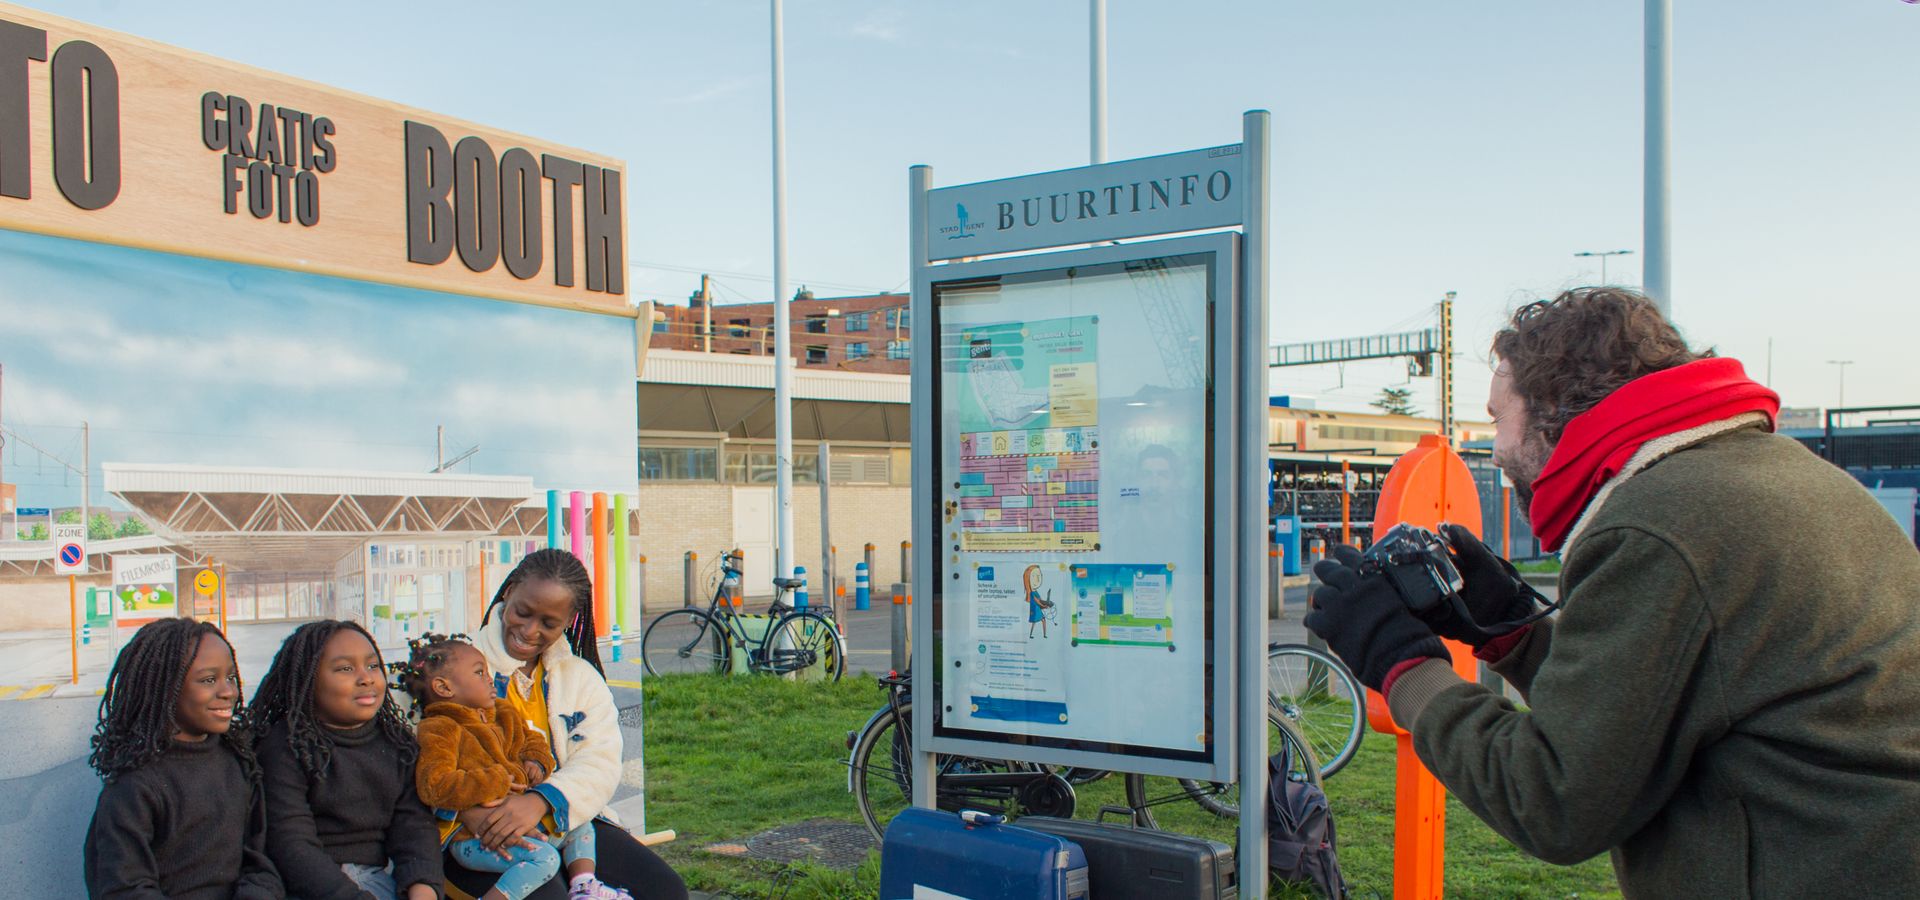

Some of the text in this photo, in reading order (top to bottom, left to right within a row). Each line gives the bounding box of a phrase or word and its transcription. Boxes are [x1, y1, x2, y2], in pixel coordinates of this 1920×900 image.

[201, 91, 337, 174] GRATIS
[224, 154, 321, 227] FOTO
[404, 120, 625, 295] BOOTH
[997, 169, 1232, 231] BUURTINFO
[939, 222, 985, 234] STAD GENT
[57, 528, 84, 538] ZONE
[120, 558, 171, 583] FILEMKING
